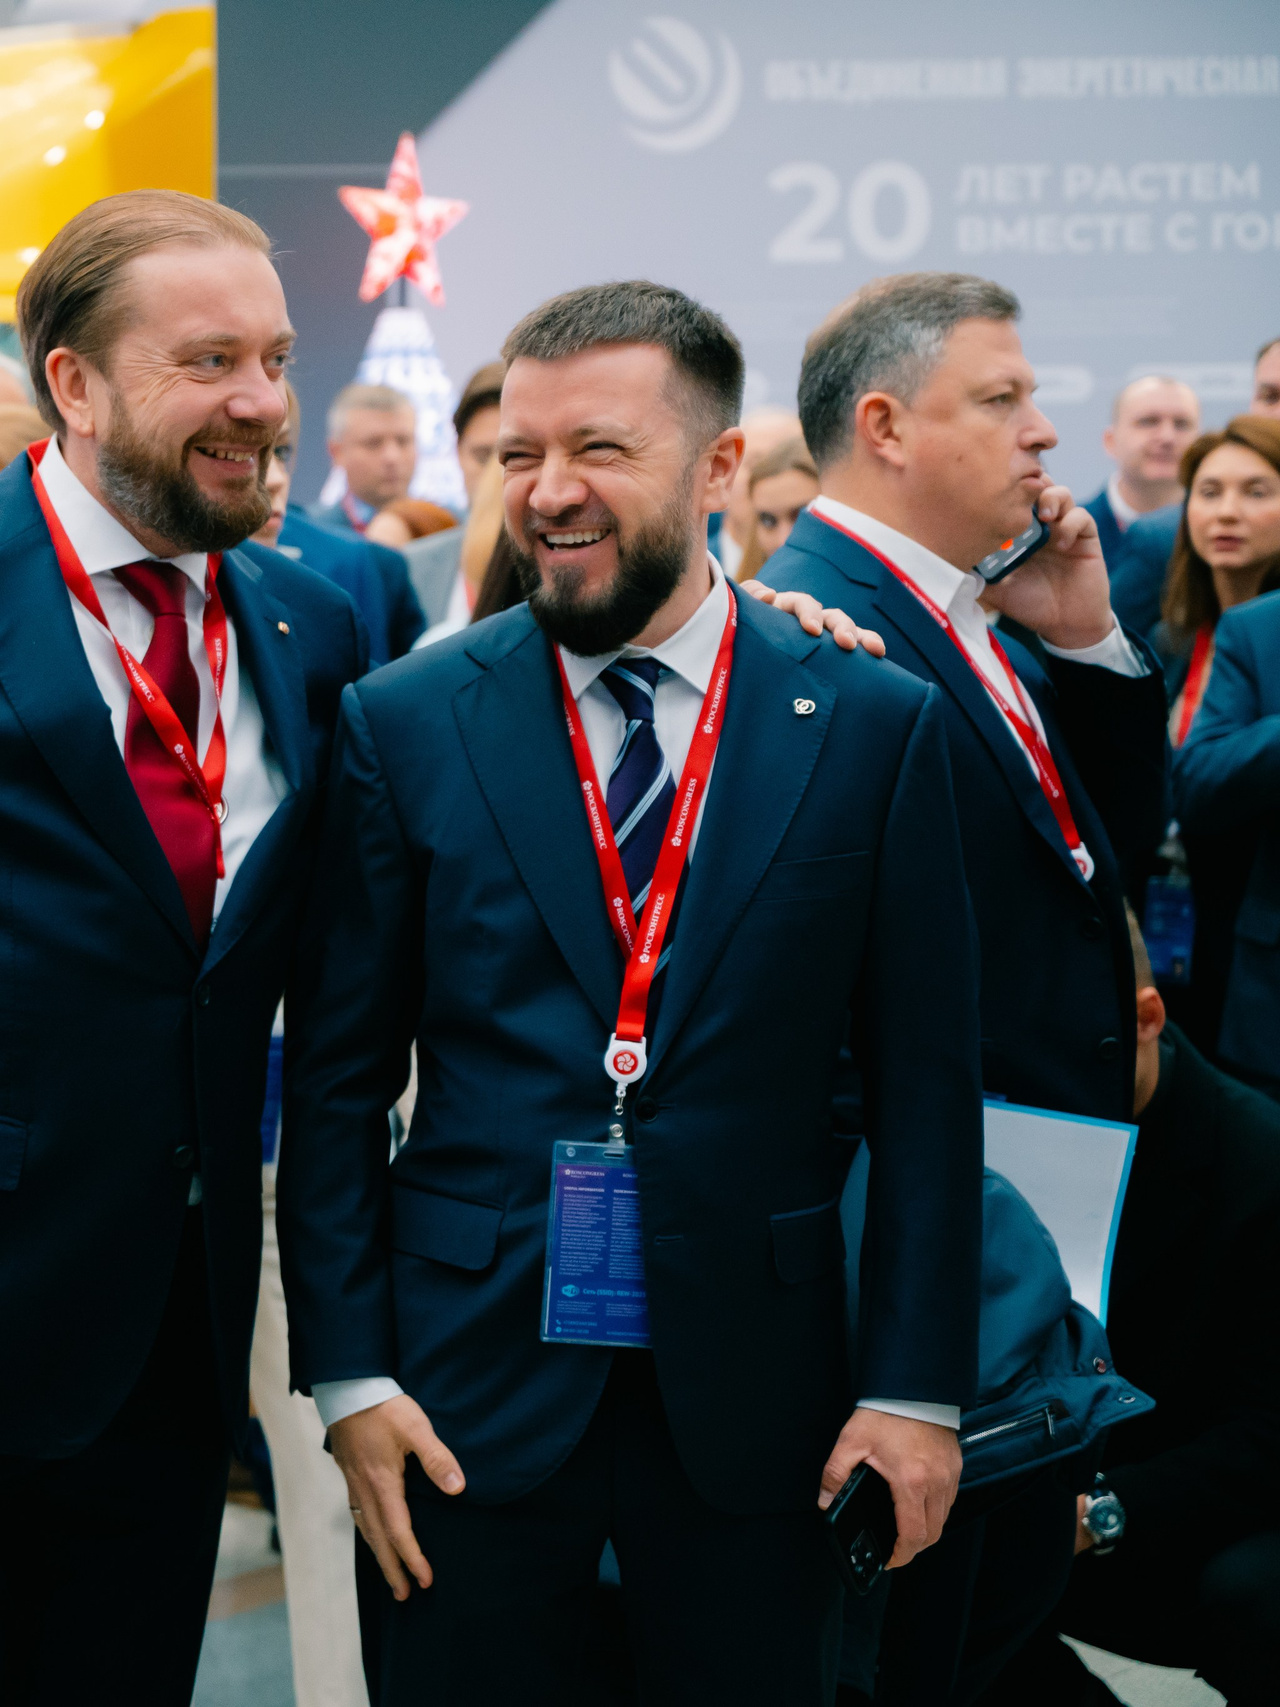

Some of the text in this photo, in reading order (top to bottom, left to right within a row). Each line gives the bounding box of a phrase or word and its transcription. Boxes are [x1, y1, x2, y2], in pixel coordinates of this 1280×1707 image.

[768, 160, 932, 263] 20
[954, 162, 1260, 202] ЛЕТ РАСТЕМ
[957, 212, 1280, 253] ВМЕСТЕ С ГО
[706, 667, 728, 726] РОСКОНГРЕСС
[586, 791, 608, 850] РОСКОНГРЕСС
[674, 777, 698, 838] ROSCONGRESS
[642, 893, 666, 954] РОСКОНГРЕСС
